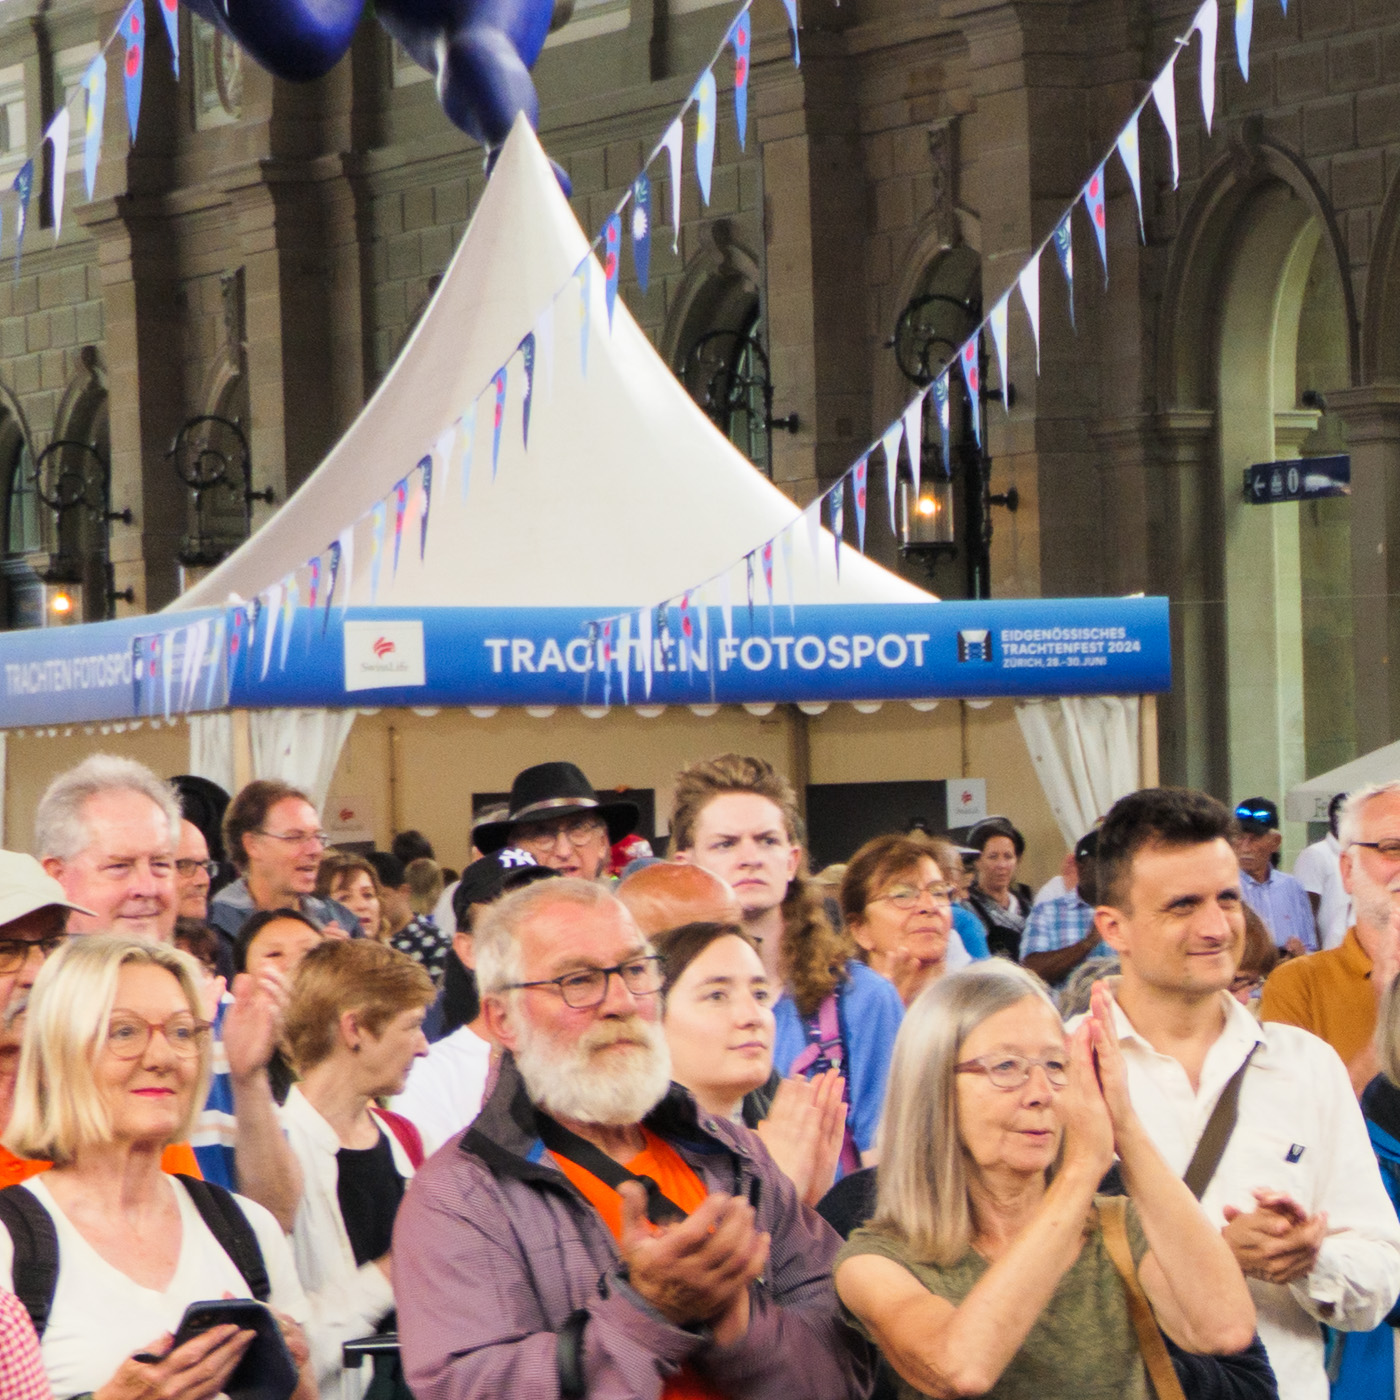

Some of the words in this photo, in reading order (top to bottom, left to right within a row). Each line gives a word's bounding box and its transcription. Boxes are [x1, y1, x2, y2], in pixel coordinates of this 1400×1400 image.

[1001, 627, 1126, 641] EIDGENÖSSISCHES
[1001, 641, 1104, 655] TRACHTENFEST
[1107, 640, 1141, 653] 2024
[484, 638, 708, 673] TRACHTEN
[718, 633, 930, 671] FOTOSPOT
[73, 651, 133, 691] FOTOSPO
